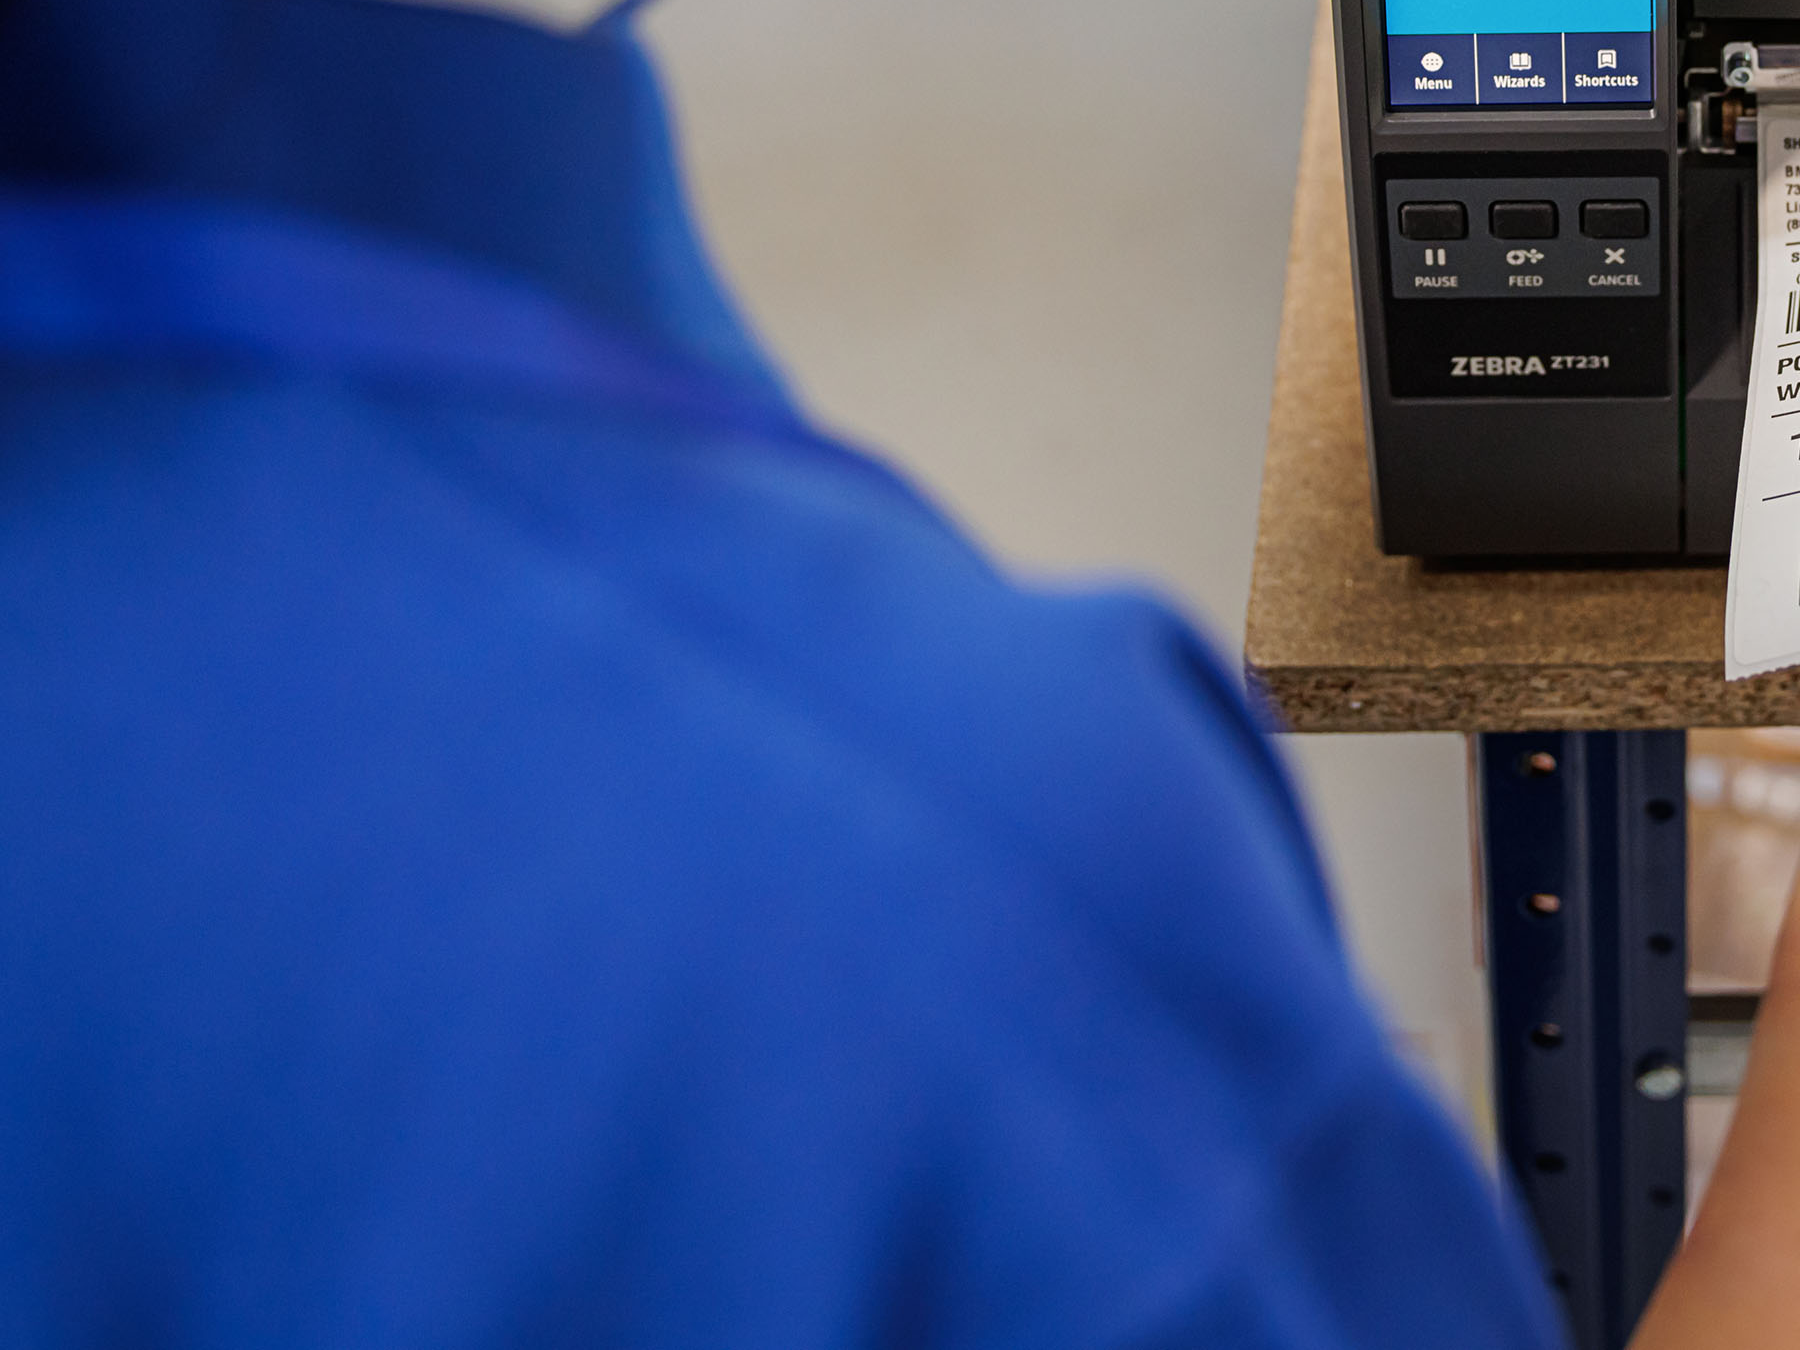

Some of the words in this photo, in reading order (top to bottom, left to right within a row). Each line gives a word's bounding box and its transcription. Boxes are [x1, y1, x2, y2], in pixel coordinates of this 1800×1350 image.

[1415, 77, 1452, 89] Menu
[1494, 75, 1545, 88] Wizards
[1575, 74, 1638, 86] Shortcuts
[1415, 276, 1458, 287] PAUSE
[1509, 275, 1542, 286] FEED
[1588, 274, 1641, 286] CANCEL
[1451, 356, 1546, 375] ZEBRA
[1551, 356, 1609, 369] ZT231
